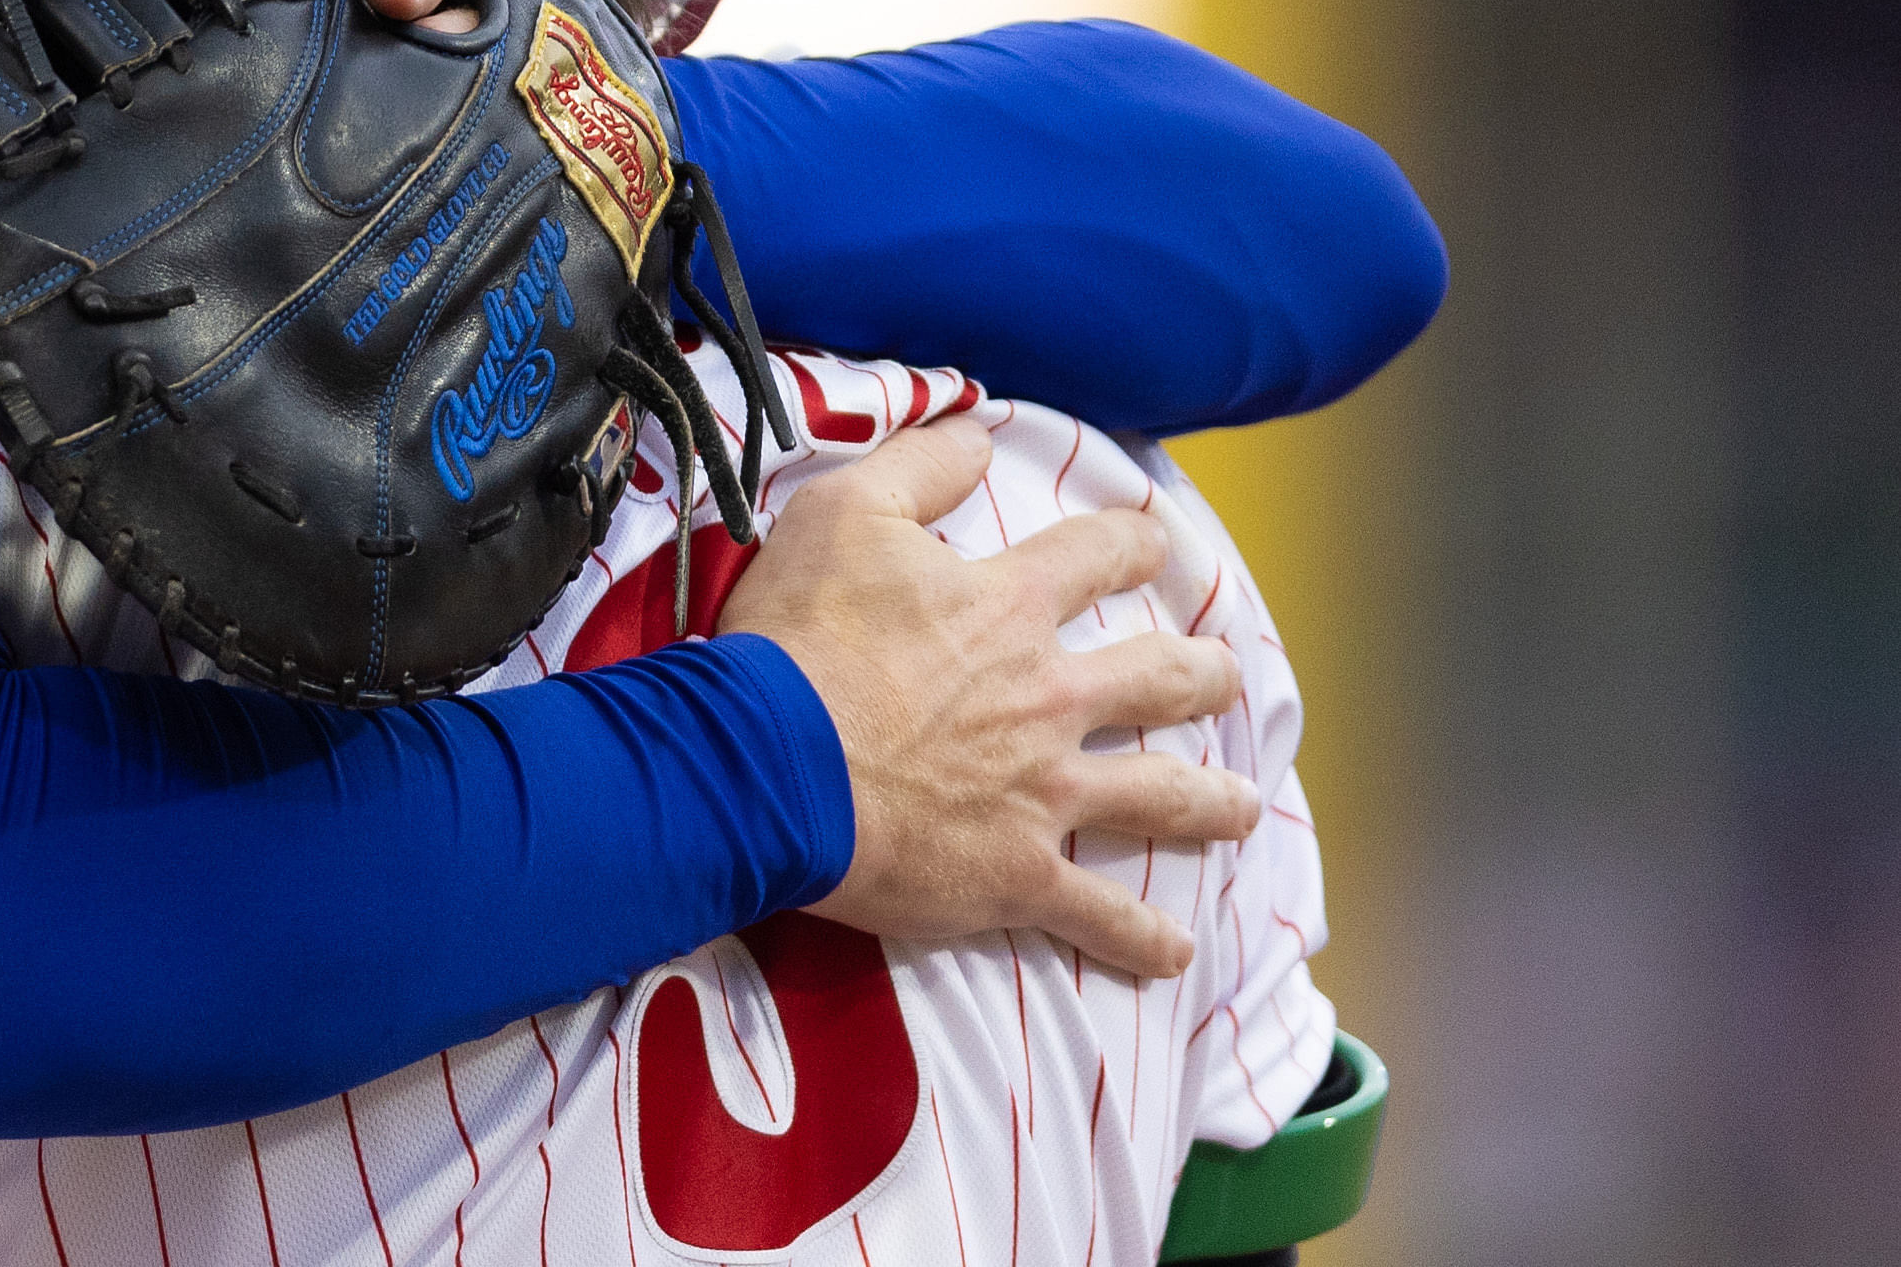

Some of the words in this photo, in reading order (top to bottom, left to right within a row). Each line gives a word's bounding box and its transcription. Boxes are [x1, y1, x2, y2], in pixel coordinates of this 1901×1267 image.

[550, 63, 653, 219] Rawlings
[342, 290, 390, 348] THE
[379, 236, 432, 301] GOLD
[426, 169, 487, 245] GLOVE
[430, 217, 576, 504] Rawlings
